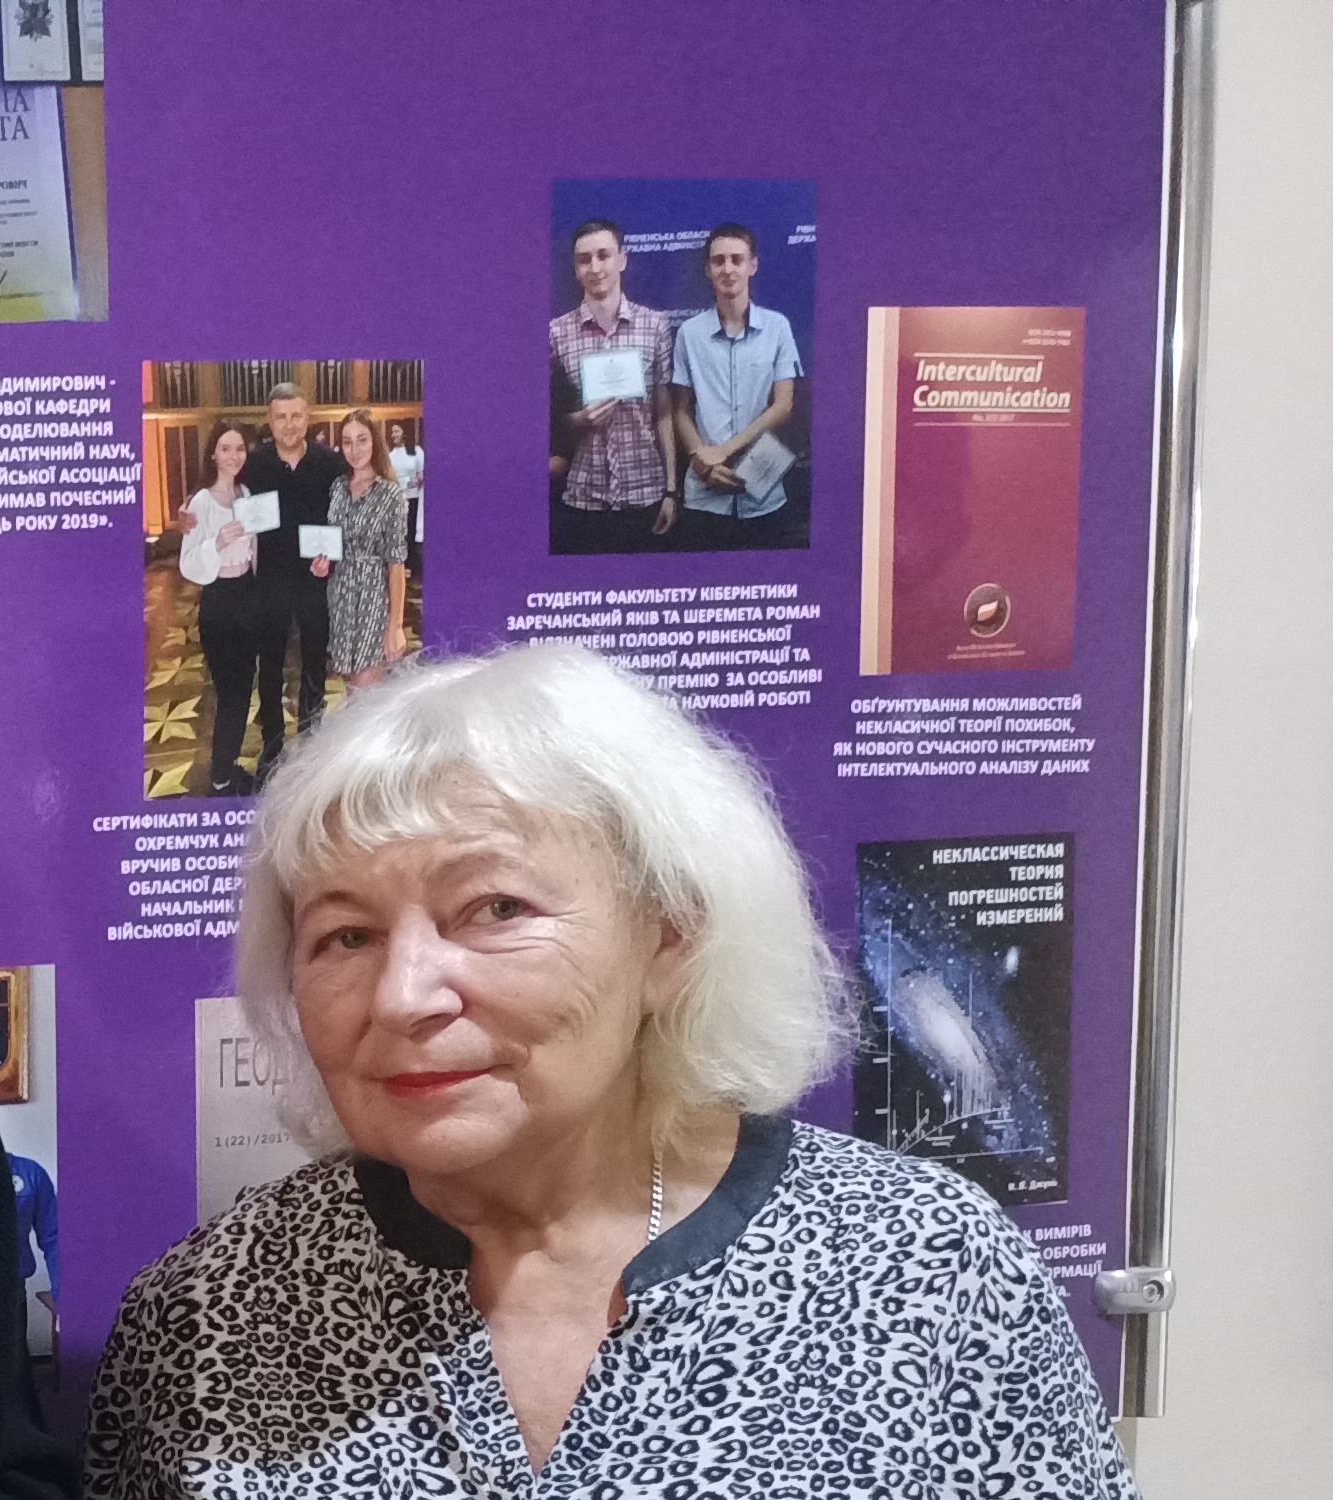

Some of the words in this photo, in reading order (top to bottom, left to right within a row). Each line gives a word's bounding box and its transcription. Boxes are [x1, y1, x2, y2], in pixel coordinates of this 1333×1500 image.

[916, 359, 1043, 382] Intercultural
[913, 385, 1071, 407] Communication
[35, 398, 111, 416] КАФЕДРИ
[89, 444, 135, 461] НАУК,
[59, 462, 141, 485] АСОЦІАЦІЇ
[50, 486, 135, 506] ПОЧЕСНИЙ
[16, 515, 57, 530] РОКУ
[61, 513, 113, 529] 2019».
[527, 591, 602, 608] СТУДЕНТИ
[606, 588, 697, 605] ФАКУЛЬТЕТУ
[700, 584, 798, 601] КІБЕРНЕТИКИ
[507, 609, 622, 631] ЗАРЕЧАНСЬКИЙ
[626, 610, 659, 625] ЯКІВ
[663, 610, 680, 624] ТА
[684, 606, 763, 623] ШЕРЕМЕТА
[766, 605, 820, 620] РОМАН
[620, 631, 694, 647] ГОЛОВОЮ
[697, 625, 792, 645] РІВНЕНСЬКОЇ
[679, 646, 789, 668] АДМІНІСТРАЦІЇ
[658, 673, 719, 689] ПРЕМІЮ
[726, 672, 744, 687] ЗА
[748, 669, 823, 686] ОСОБЛИВІ
[682, 690, 755, 709] НАУКОВІЙ
[758, 691, 811, 706] РОБОТІ
[850, 697, 969, 713] ОБҐРУНТУВАННЯ
[972, 694, 1082, 712] МОЖЛИВОСТЕЙ
[856, 717, 956, 734] НЕКЛАСИЧНОЇ
[958, 716, 1003, 733] ТЕОРІЇ
[1005, 718, 1076, 733] ПОХИБОК,
[833, 743, 852, 756] ЯК
[856, 741, 914, 756] НОВОГО
[917, 739, 998, 756] СУЧАСНОГО
[1001, 738, 1096, 753] ІНСТРУМЕНТУ
[837, 761, 976, 777] ІНТЕЛЕКТУАЛЬНОГО
[979, 760, 1038, 775] АНАЛІЗУ
[1041, 759, 1090, 775] ДАНИХ
[93, 813, 198, 832] СЕРТИФІКАТИ
[201, 812, 221, 826] ЗА
[135, 834, 219, 851] ОХРЕМЧУК
[933, 842, 1065, 864] НЕКЛАССИЧЕСКАЯ
[121, 857, 181, 874] ВРУЧИВ
[1009, 864, 1064, 881] ТЕОРИЯ
[129, 875, 209, 896] ОБЛАСНОЇ
[948, 882, 1064, 906] ПОГРЕШНОСТЕЙ
[976, 903, 1064, 926] ИЗМЕРЕНИЙ
[108, 919, 201, 941] ВІЙСЬКОВОЇ
[1035, 1224, 1092, 1241] ВИМІРІВ
[1043, 1242, 1107, 1260] ОБРОБКИ
